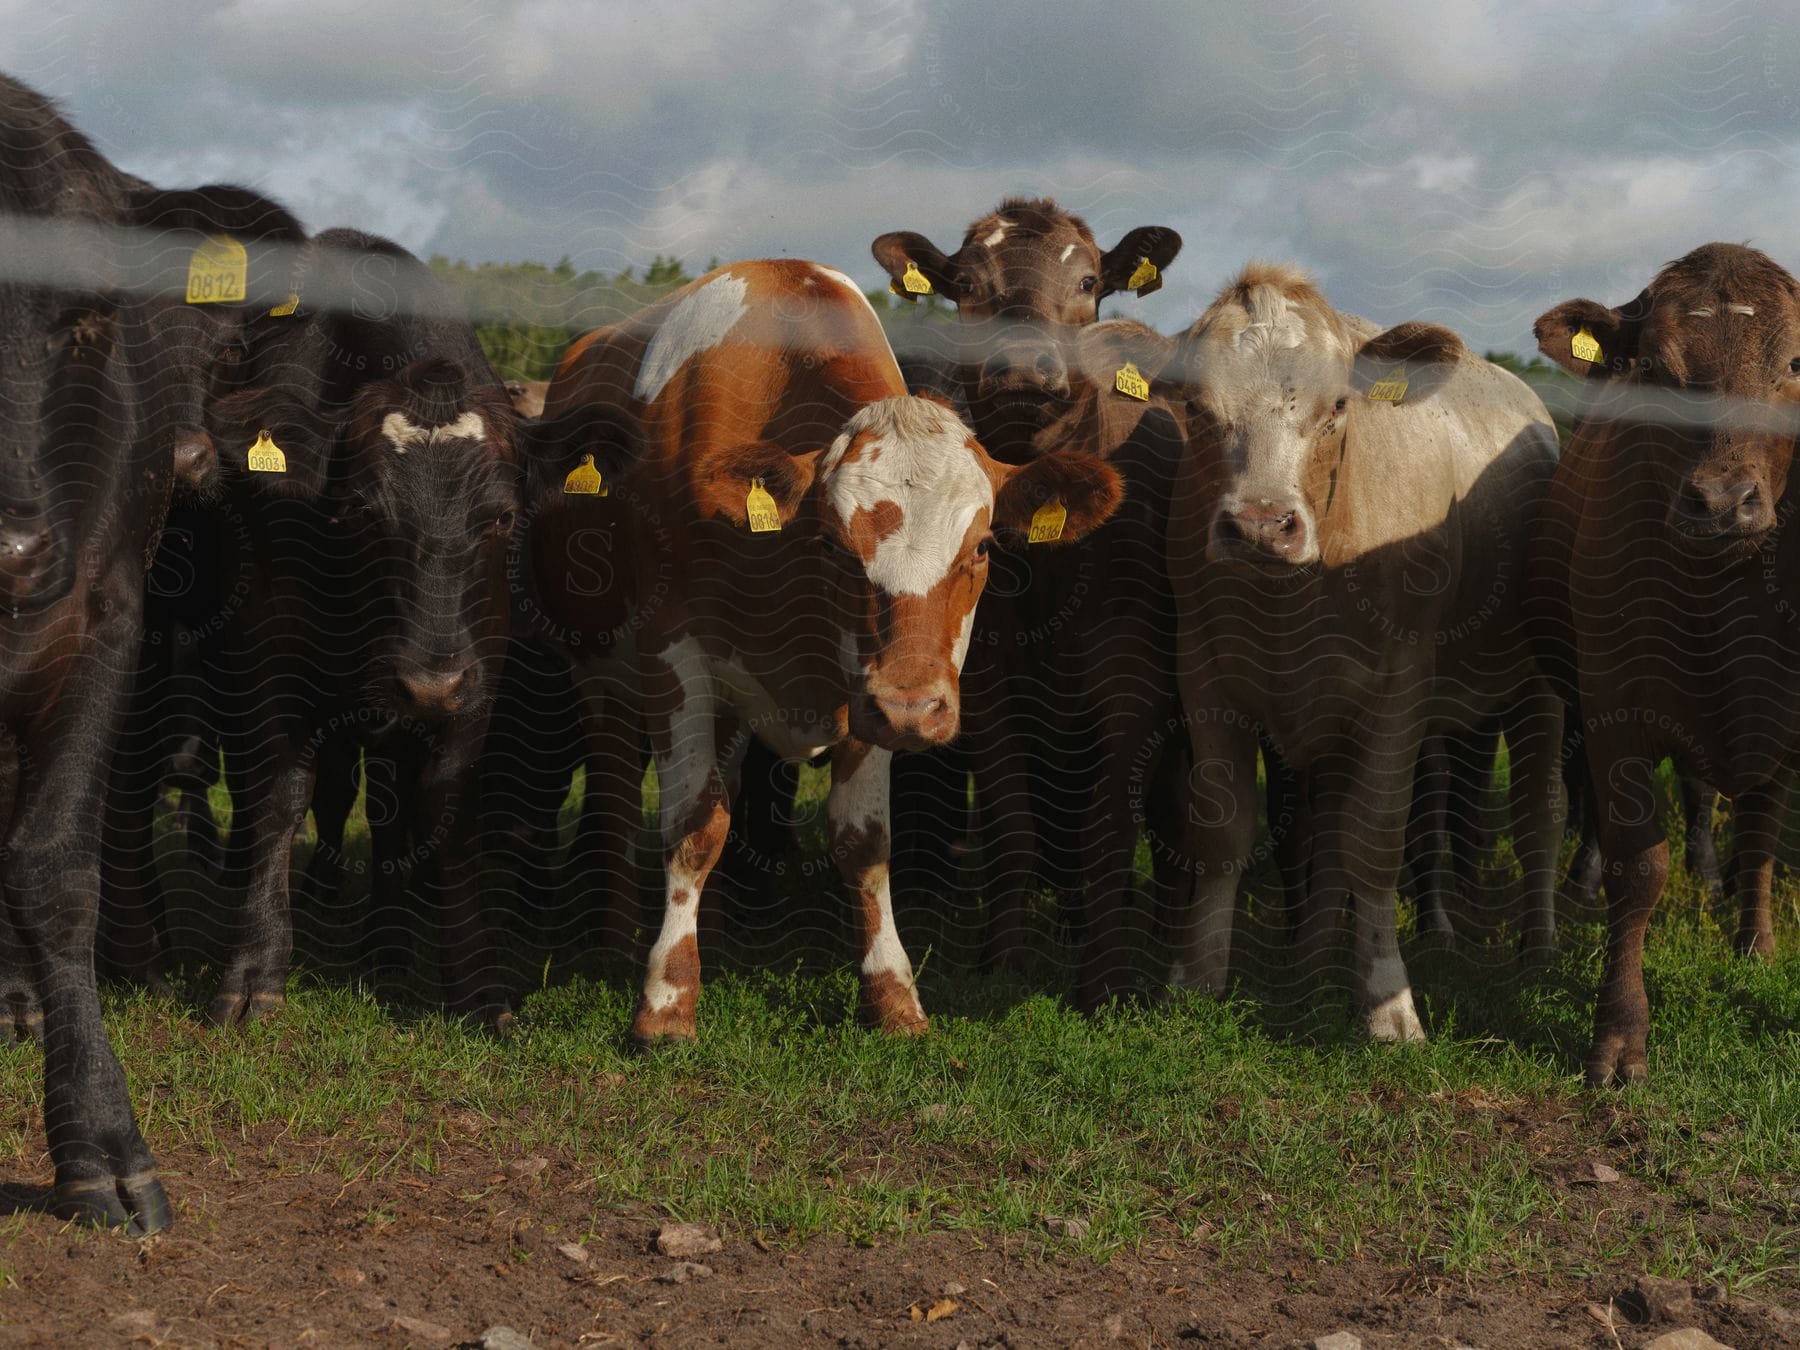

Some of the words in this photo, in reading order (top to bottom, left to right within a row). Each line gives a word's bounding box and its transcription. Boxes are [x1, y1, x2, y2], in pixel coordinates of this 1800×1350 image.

[190, 273, 235, 299] 0812
[1118, 376, 1143, 397] 0481
[250, 456, 280, 470] 0803
[751, 512, 776, 529] 0816
[1031, 525, 1058, 541] 0816
